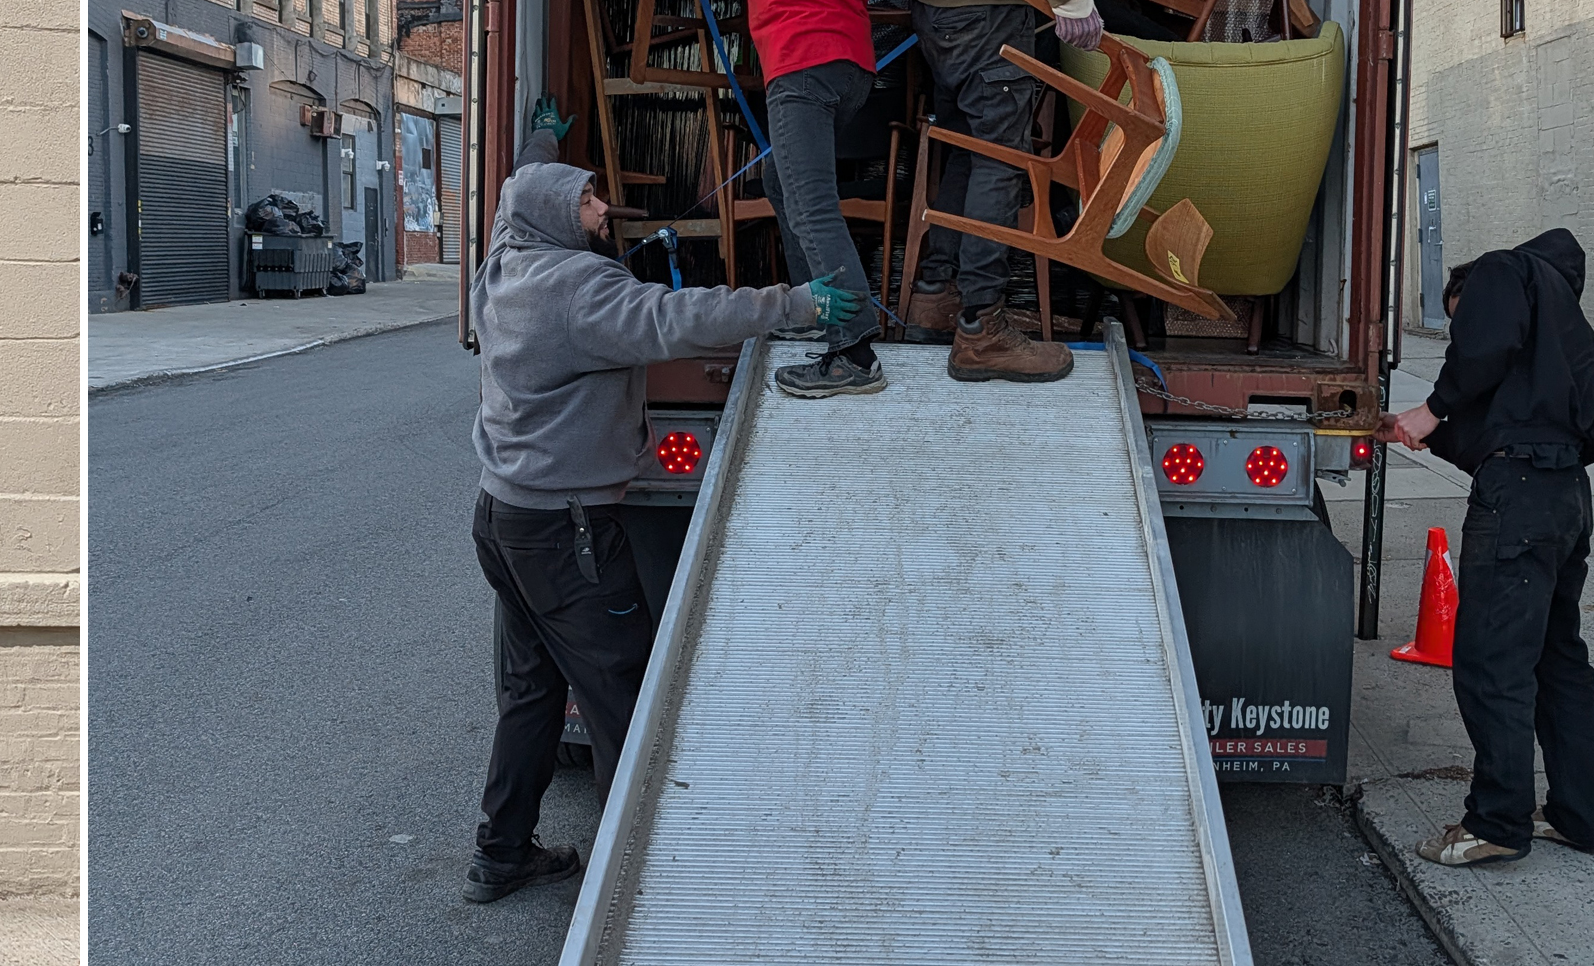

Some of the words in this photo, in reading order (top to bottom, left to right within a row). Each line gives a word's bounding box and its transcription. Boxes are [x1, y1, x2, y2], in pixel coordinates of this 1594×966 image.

[1201, 699, 1224, 736] ty
[1231, 697, 1330, 736] Keystone
[1254, 742, 1307, 753] SALES
[1273, 762, 1291, 771] PA
